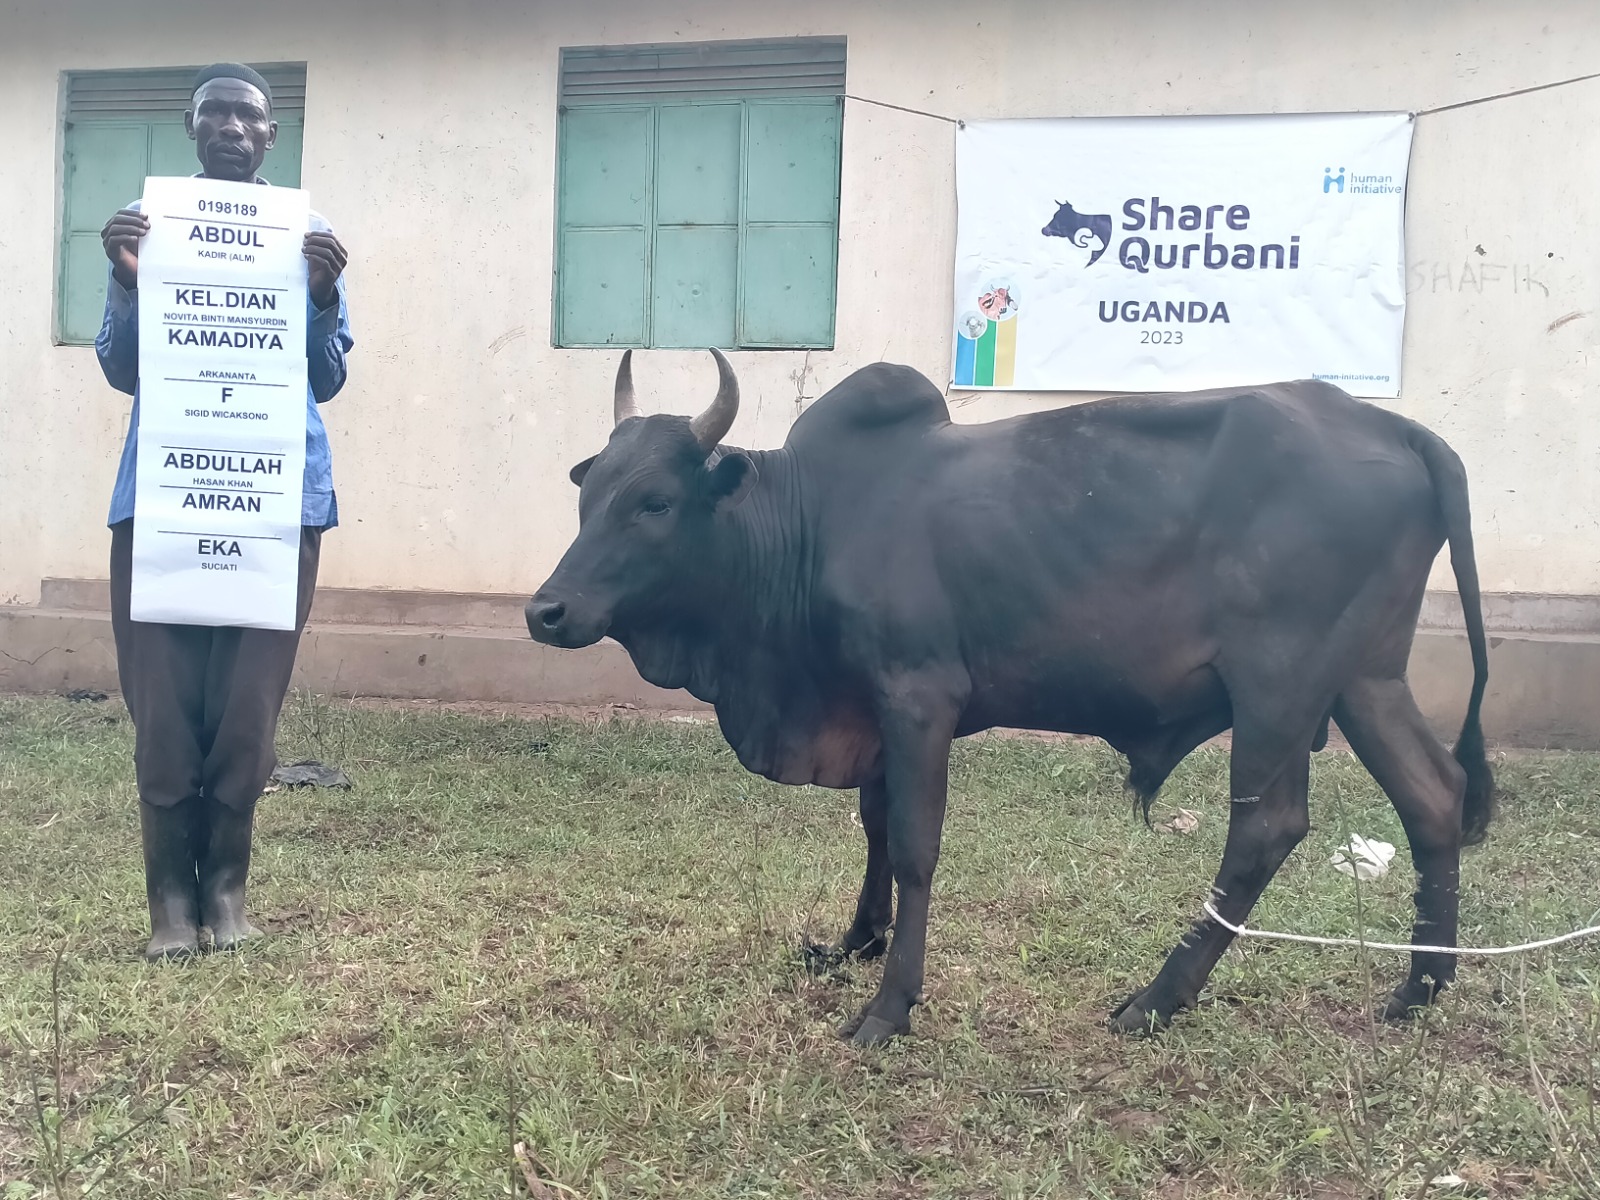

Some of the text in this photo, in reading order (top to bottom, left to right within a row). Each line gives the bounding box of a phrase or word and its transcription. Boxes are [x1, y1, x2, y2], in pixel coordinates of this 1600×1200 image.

[1350, 172, 1392, 183] human
[1350, 183, 1402, 194] initiative
[198, 199, 257, 217] 0198189
[1122, 197, 1250, 231] Share
[188, 224, 265, 248] ABDUL
[197, 249, 255, 264] KADIR (ALM)
[1118, 233, 1300, 273] Qurbani
[175, 288, 276, 311] KEL.DIAN
[163, 312, 287, 327] NOVITA BINTI MANSYURDIN
[1098, 300, 1231, 324] UGANDA
[168, 328, 284, 351] KAMADIYA
[1140, 330, 1184, 345] 2023
[198, 369, 257, 381] ARKANANTA
[221, 387, 234, 403] F
[184, 409, 269, 421] SIGID WICAKSONO
[163, 452, 282, 476] ABDULLAH
[192, 477, 253, 489] HASAN KHAN
[181, 492, 262, 514] AMRAN
[197, 538, 243, 558] EKA
[200, 562, 238, 572] SUCIATI
